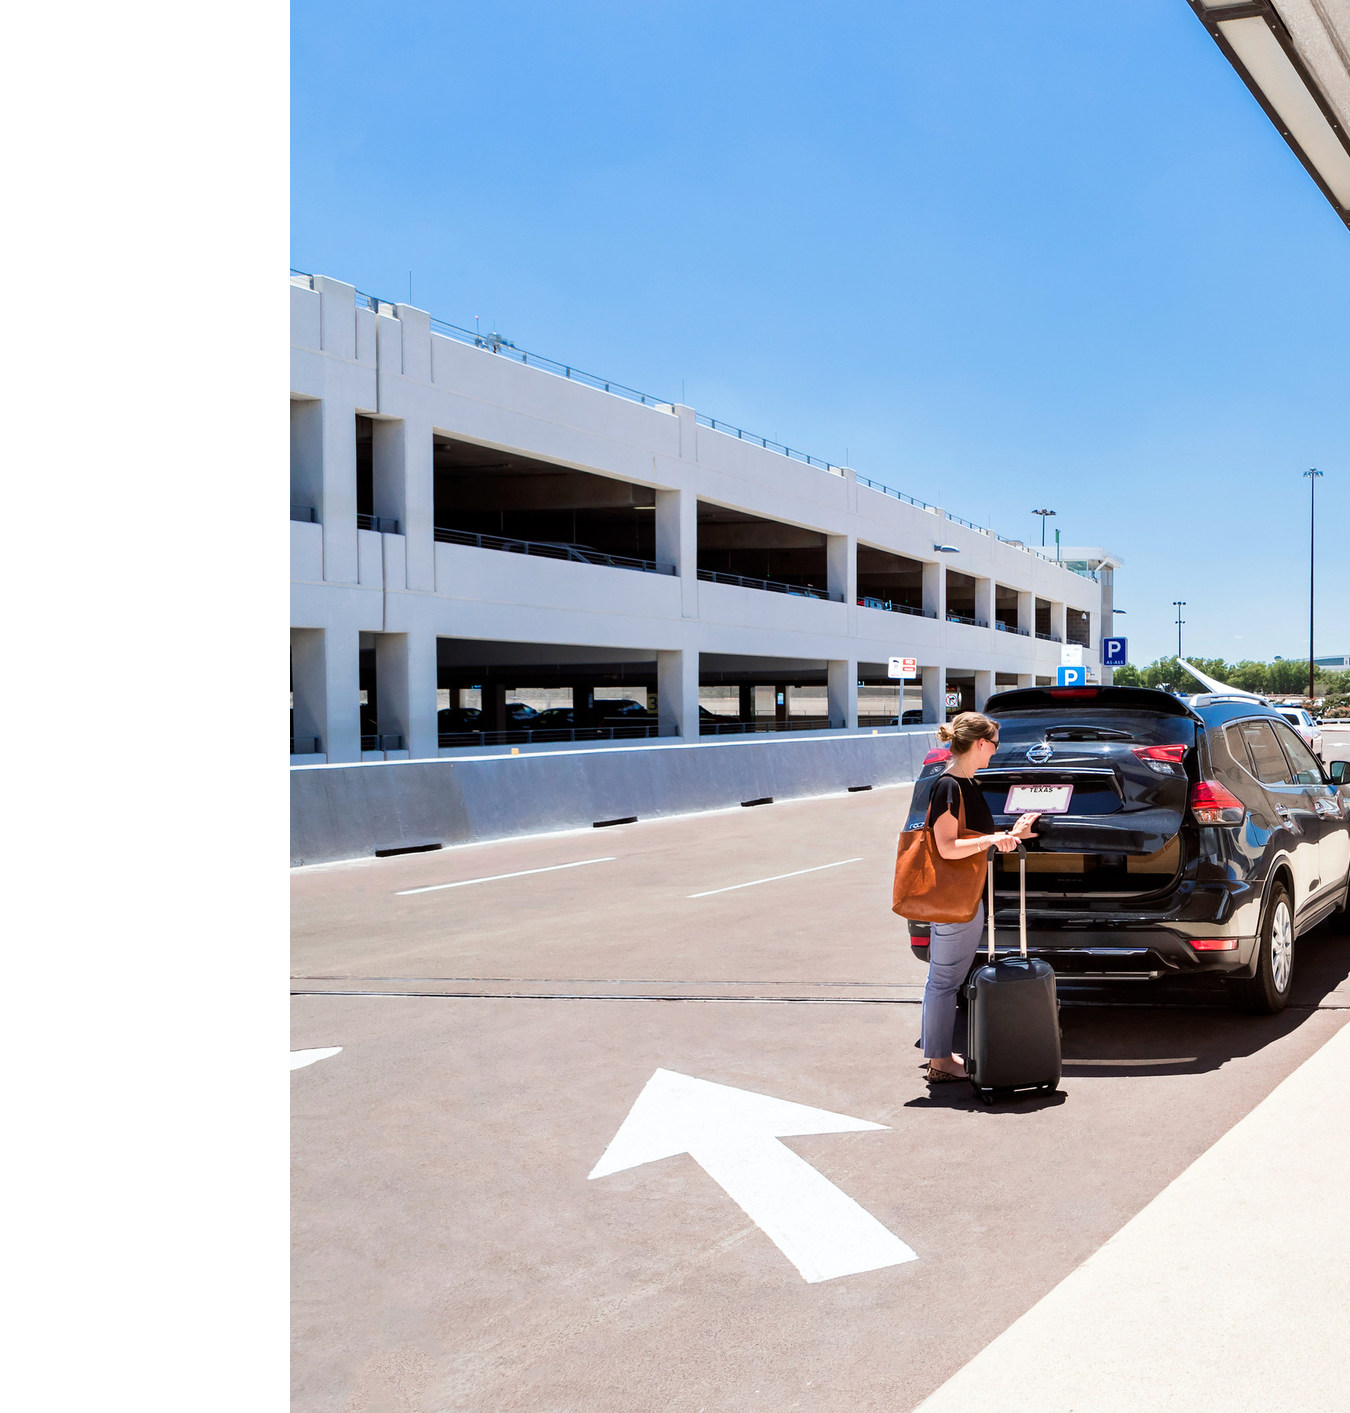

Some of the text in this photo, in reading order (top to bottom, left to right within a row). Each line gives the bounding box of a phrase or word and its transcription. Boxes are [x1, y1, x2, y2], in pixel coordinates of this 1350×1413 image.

[1108, 641, 1121, 658] P
[1064, 669, 1078, 686] P
[649, 696, 658, 710] 3
